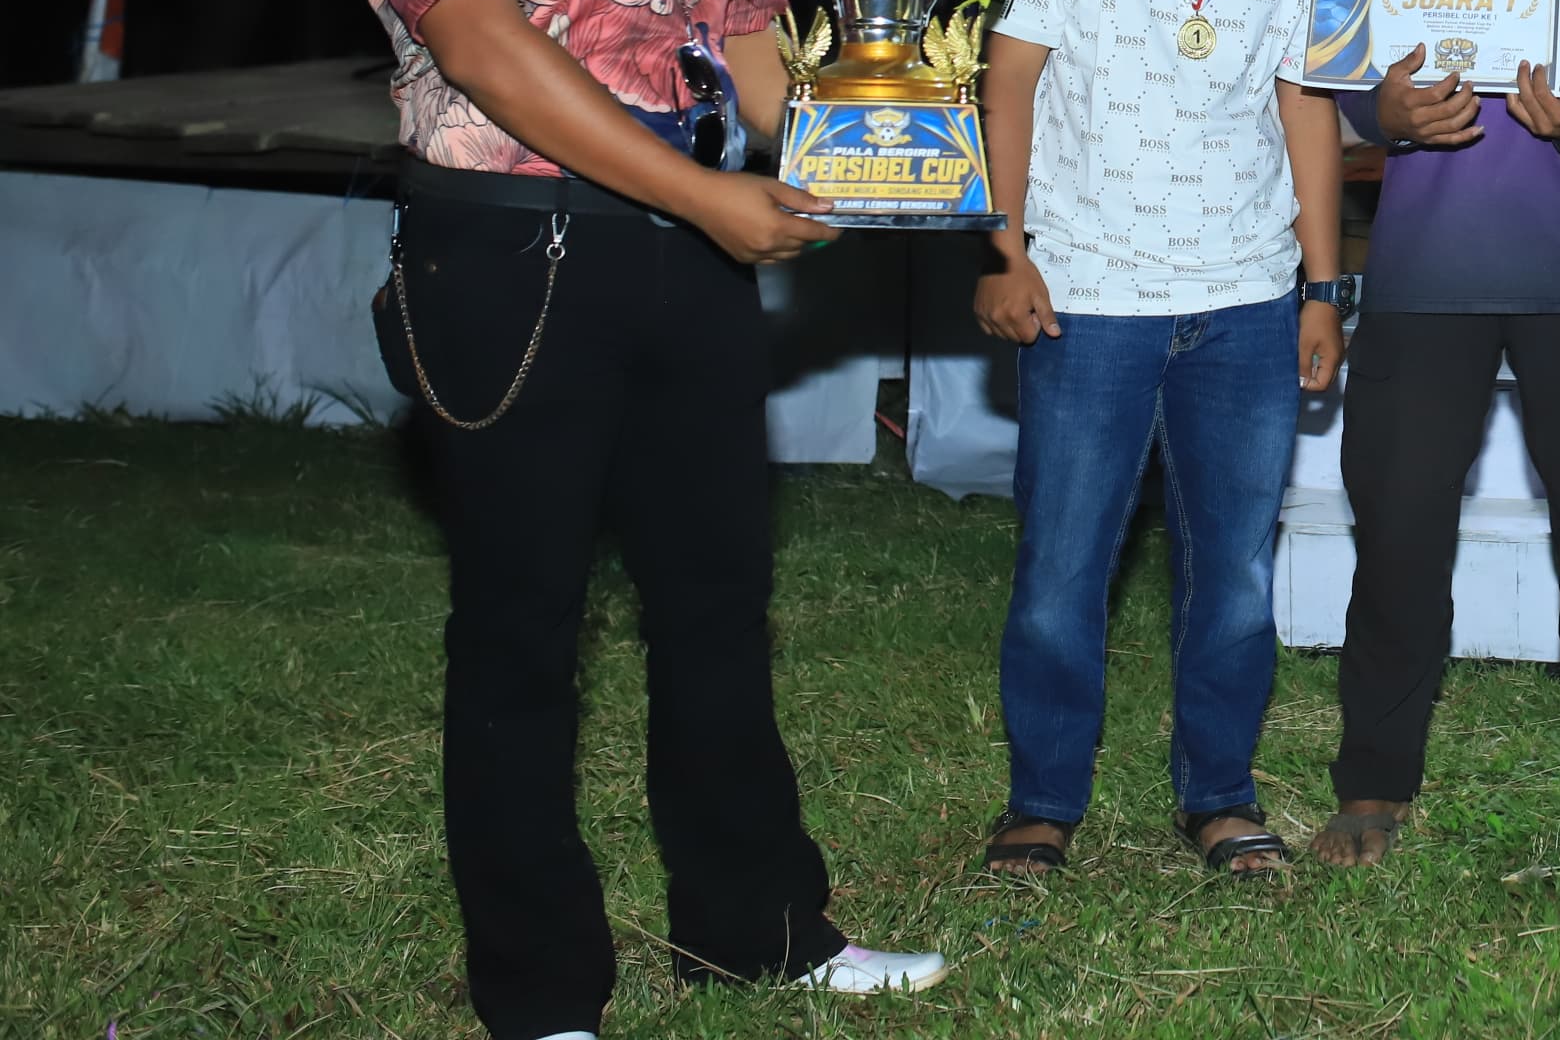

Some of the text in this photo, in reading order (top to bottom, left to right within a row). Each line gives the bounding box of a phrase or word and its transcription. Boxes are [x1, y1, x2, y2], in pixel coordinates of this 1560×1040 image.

[1150, 8, 1179, 22] BOSS
[1422, 11, 1460, 20] PERSIBEL
[1214, 18, 1246, 30] BOSS
[1115, 35, 1146, 46] BOSS
[1192, 29, 1201, 45] 1
[1145, 72, 1176, 84] BOSS
[1108, 101, 1140, 113] BOSS
[1176, 109, 1207, 120] BOSS
[1080, 130, 1104, 143] BOSS
[1139, 138, 1170, 150] BOSS
[1203, 140, 1230, 150] BOSS
[833, 146, 873, 157] PIALA
[1058, 154, 1079, 170] BOSS
[800, 155, 971, 184] PERSIBEL CUP
[1103, 168, 1134, 180] BOSS
[1171, 174, 1203, 184] BOSS
[1235, 171, 1258, 182] BOSS
[1027, 175, 1055, 193] BOSS
[1077, 194, 1100, 209] BOSS
[1135, 205, 1167, 215] BOSS
[1203, 205, 1233, 215] BOSS
[1103, 232, 1131, 245] BOSS
[1168, 237, 1200, 247] BOSS
[1107, 258, 1138, 271] BOSS
[1068, 287, 1100, 298] BOSS
[1207, 280, 1239, 294] BOSS
[1138, 290, 1171, 300] BOSS
